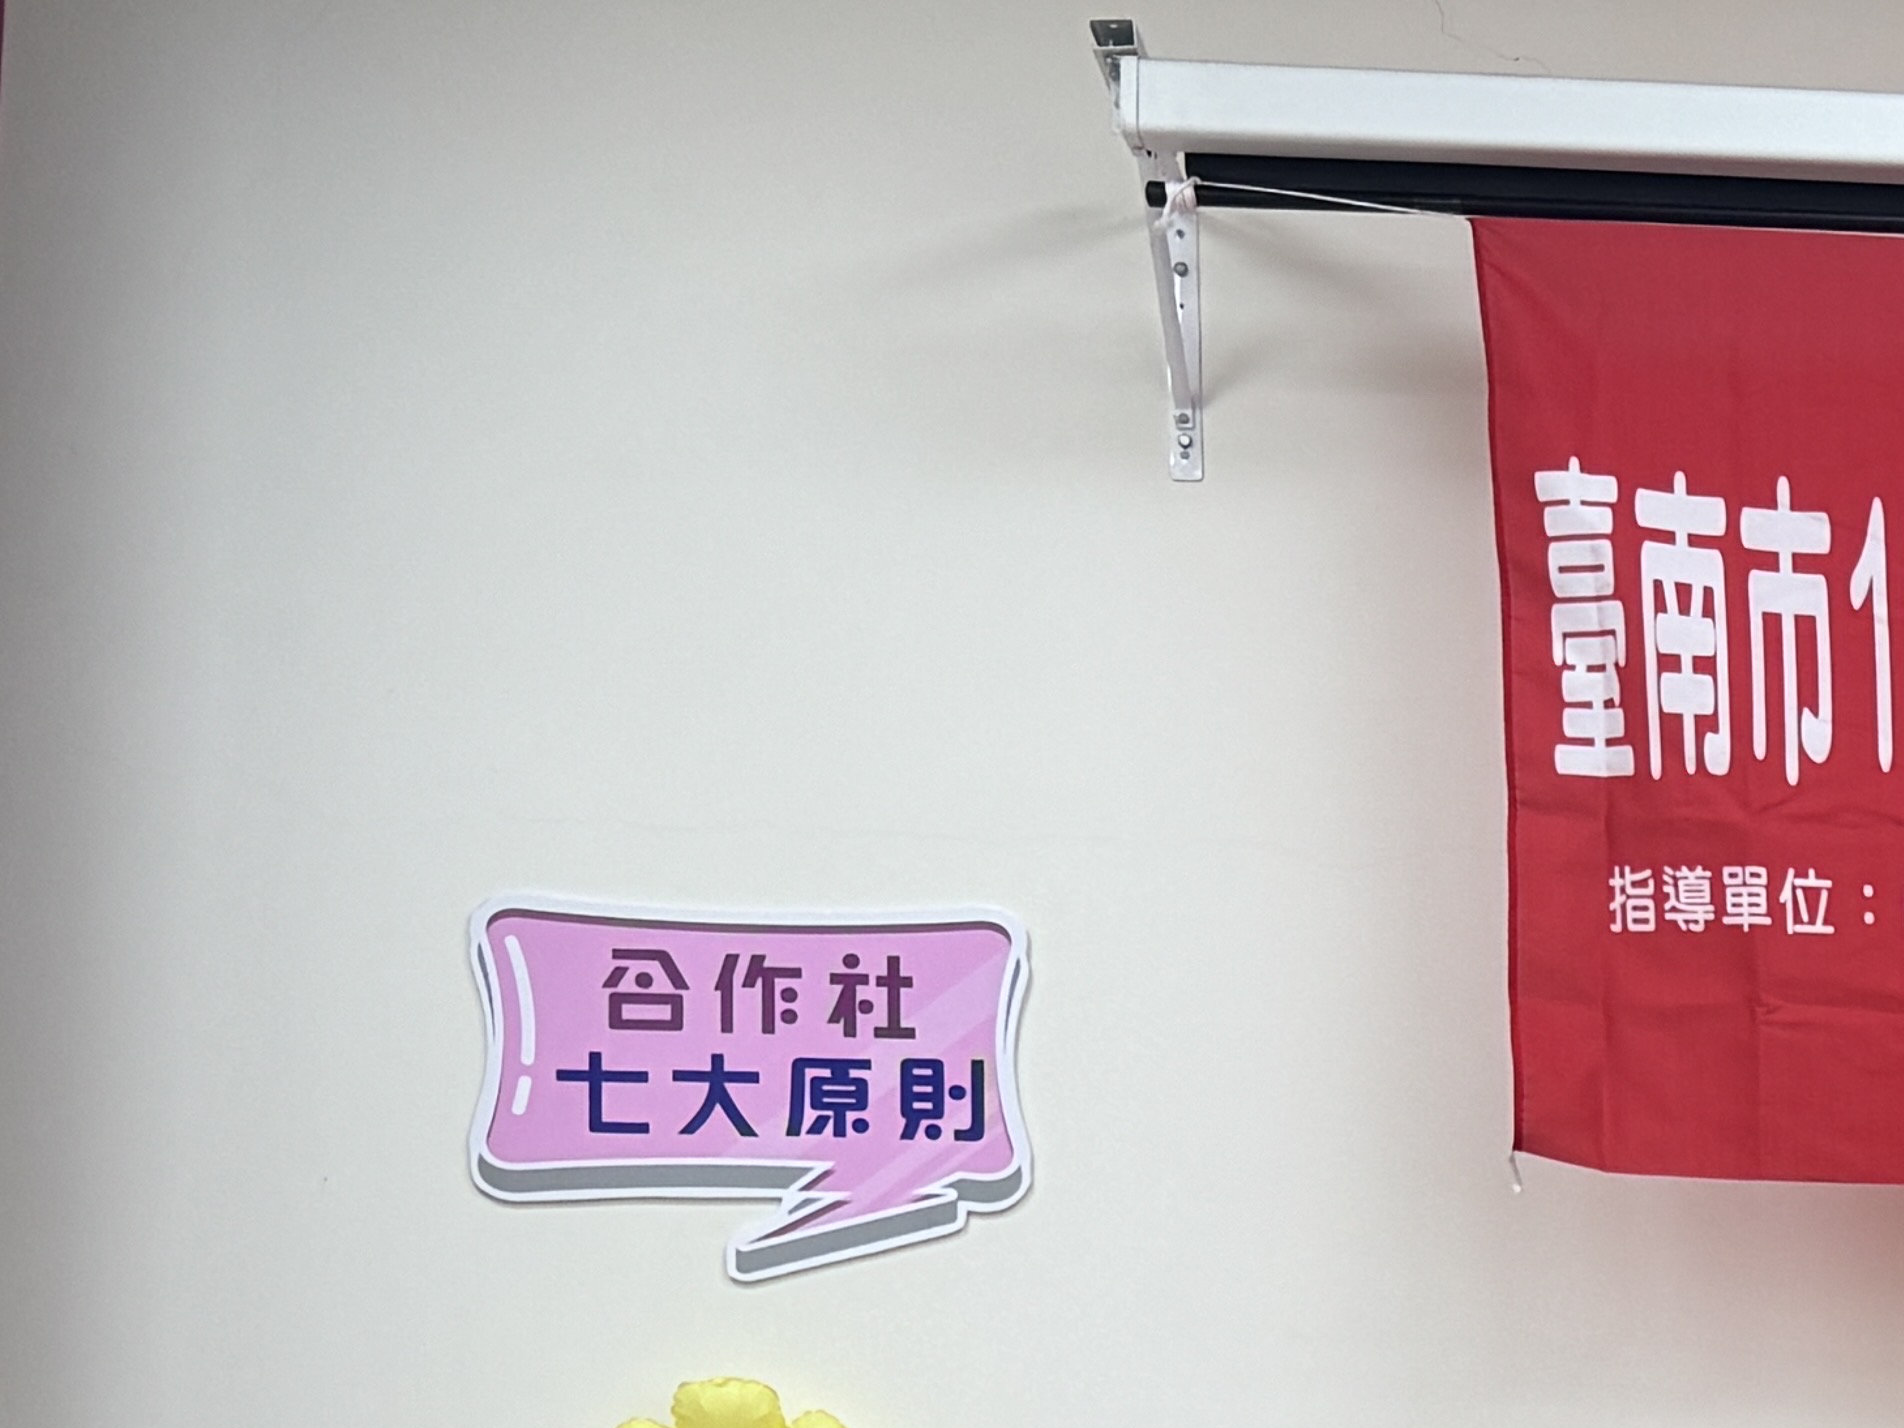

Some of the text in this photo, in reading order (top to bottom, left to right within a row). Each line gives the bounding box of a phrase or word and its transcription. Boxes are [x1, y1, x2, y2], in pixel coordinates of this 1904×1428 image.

[602, 948, 916, 1040] 合作社
[556, 1051, 985, 1142] 七大原則
